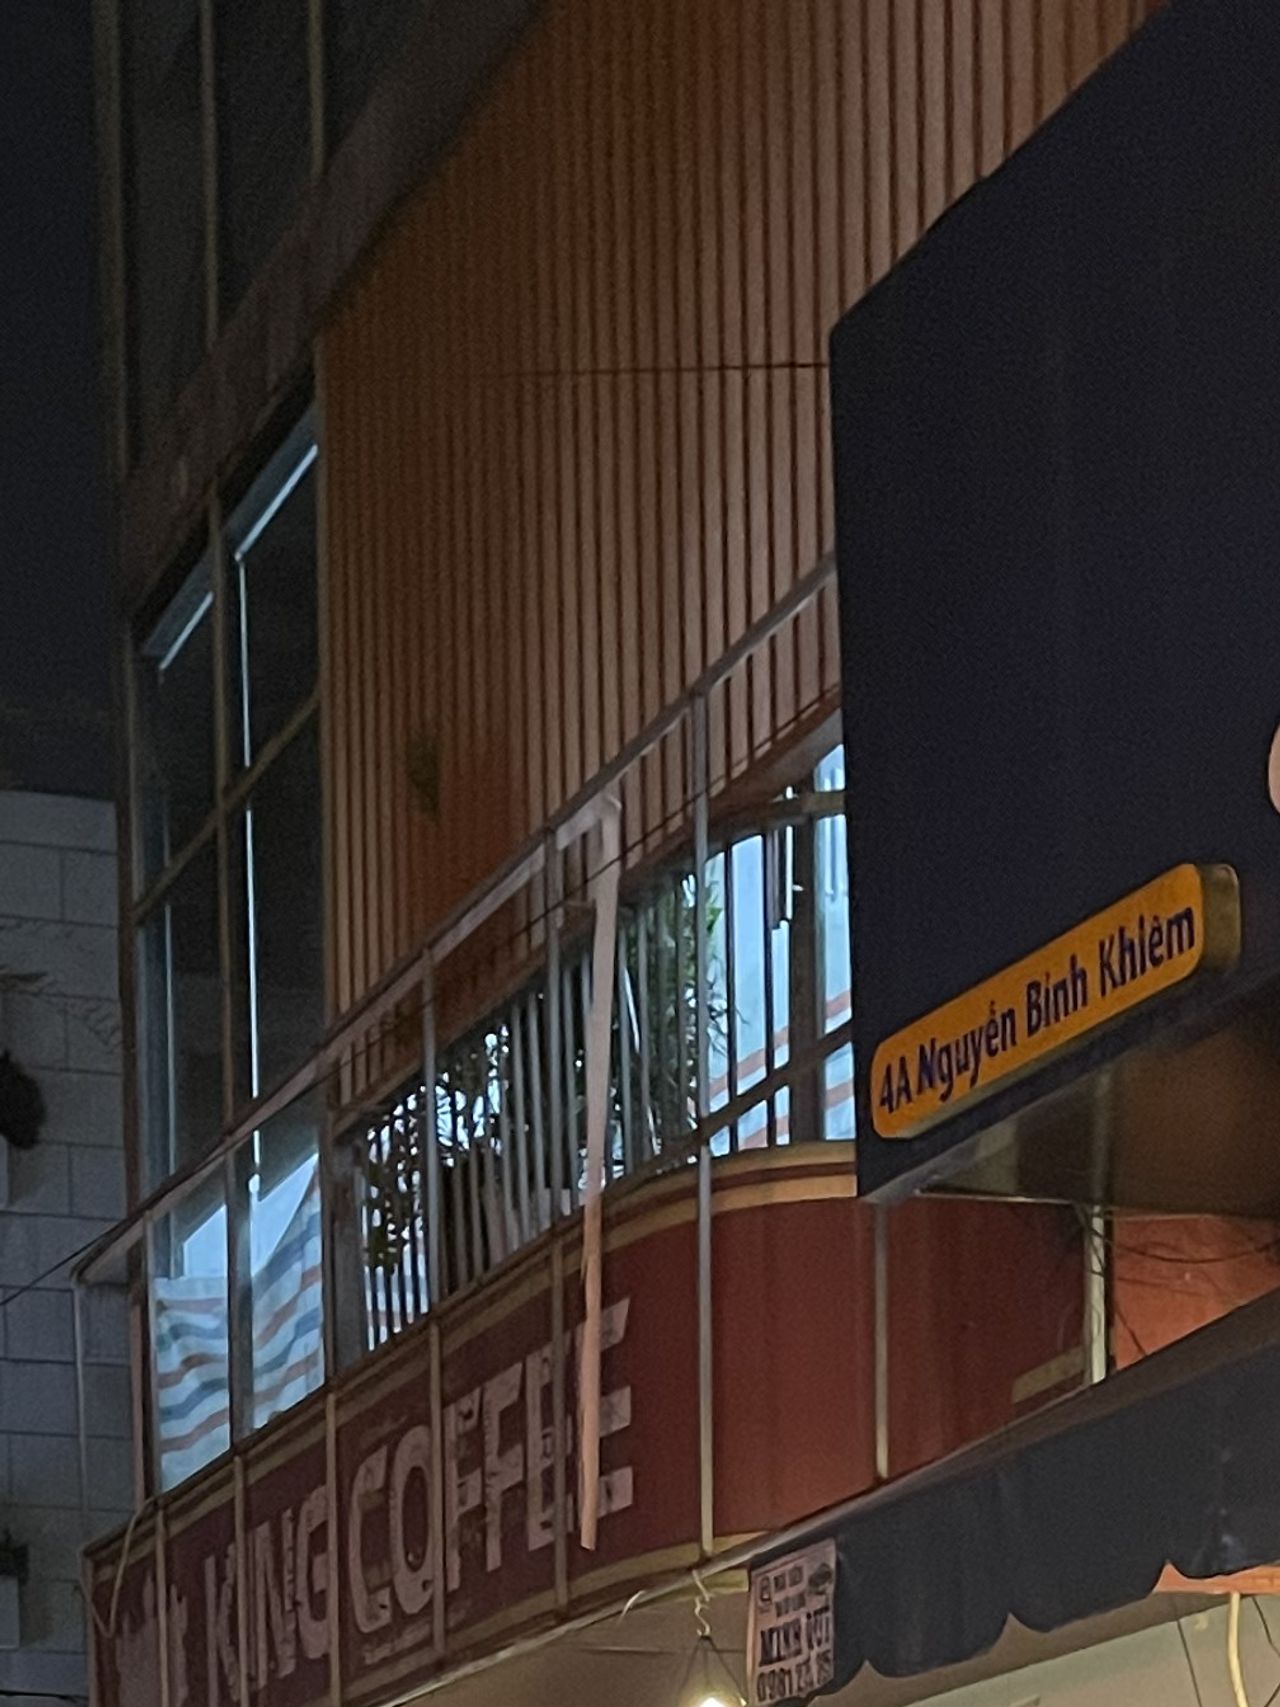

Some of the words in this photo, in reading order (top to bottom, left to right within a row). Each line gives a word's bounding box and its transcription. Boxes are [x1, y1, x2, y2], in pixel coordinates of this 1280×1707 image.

[878, 1055, 914, 1115] 4A
[1097, 906, 1196, 998] Khiêm
[349, 1297, 634, 1634] COFFEE
